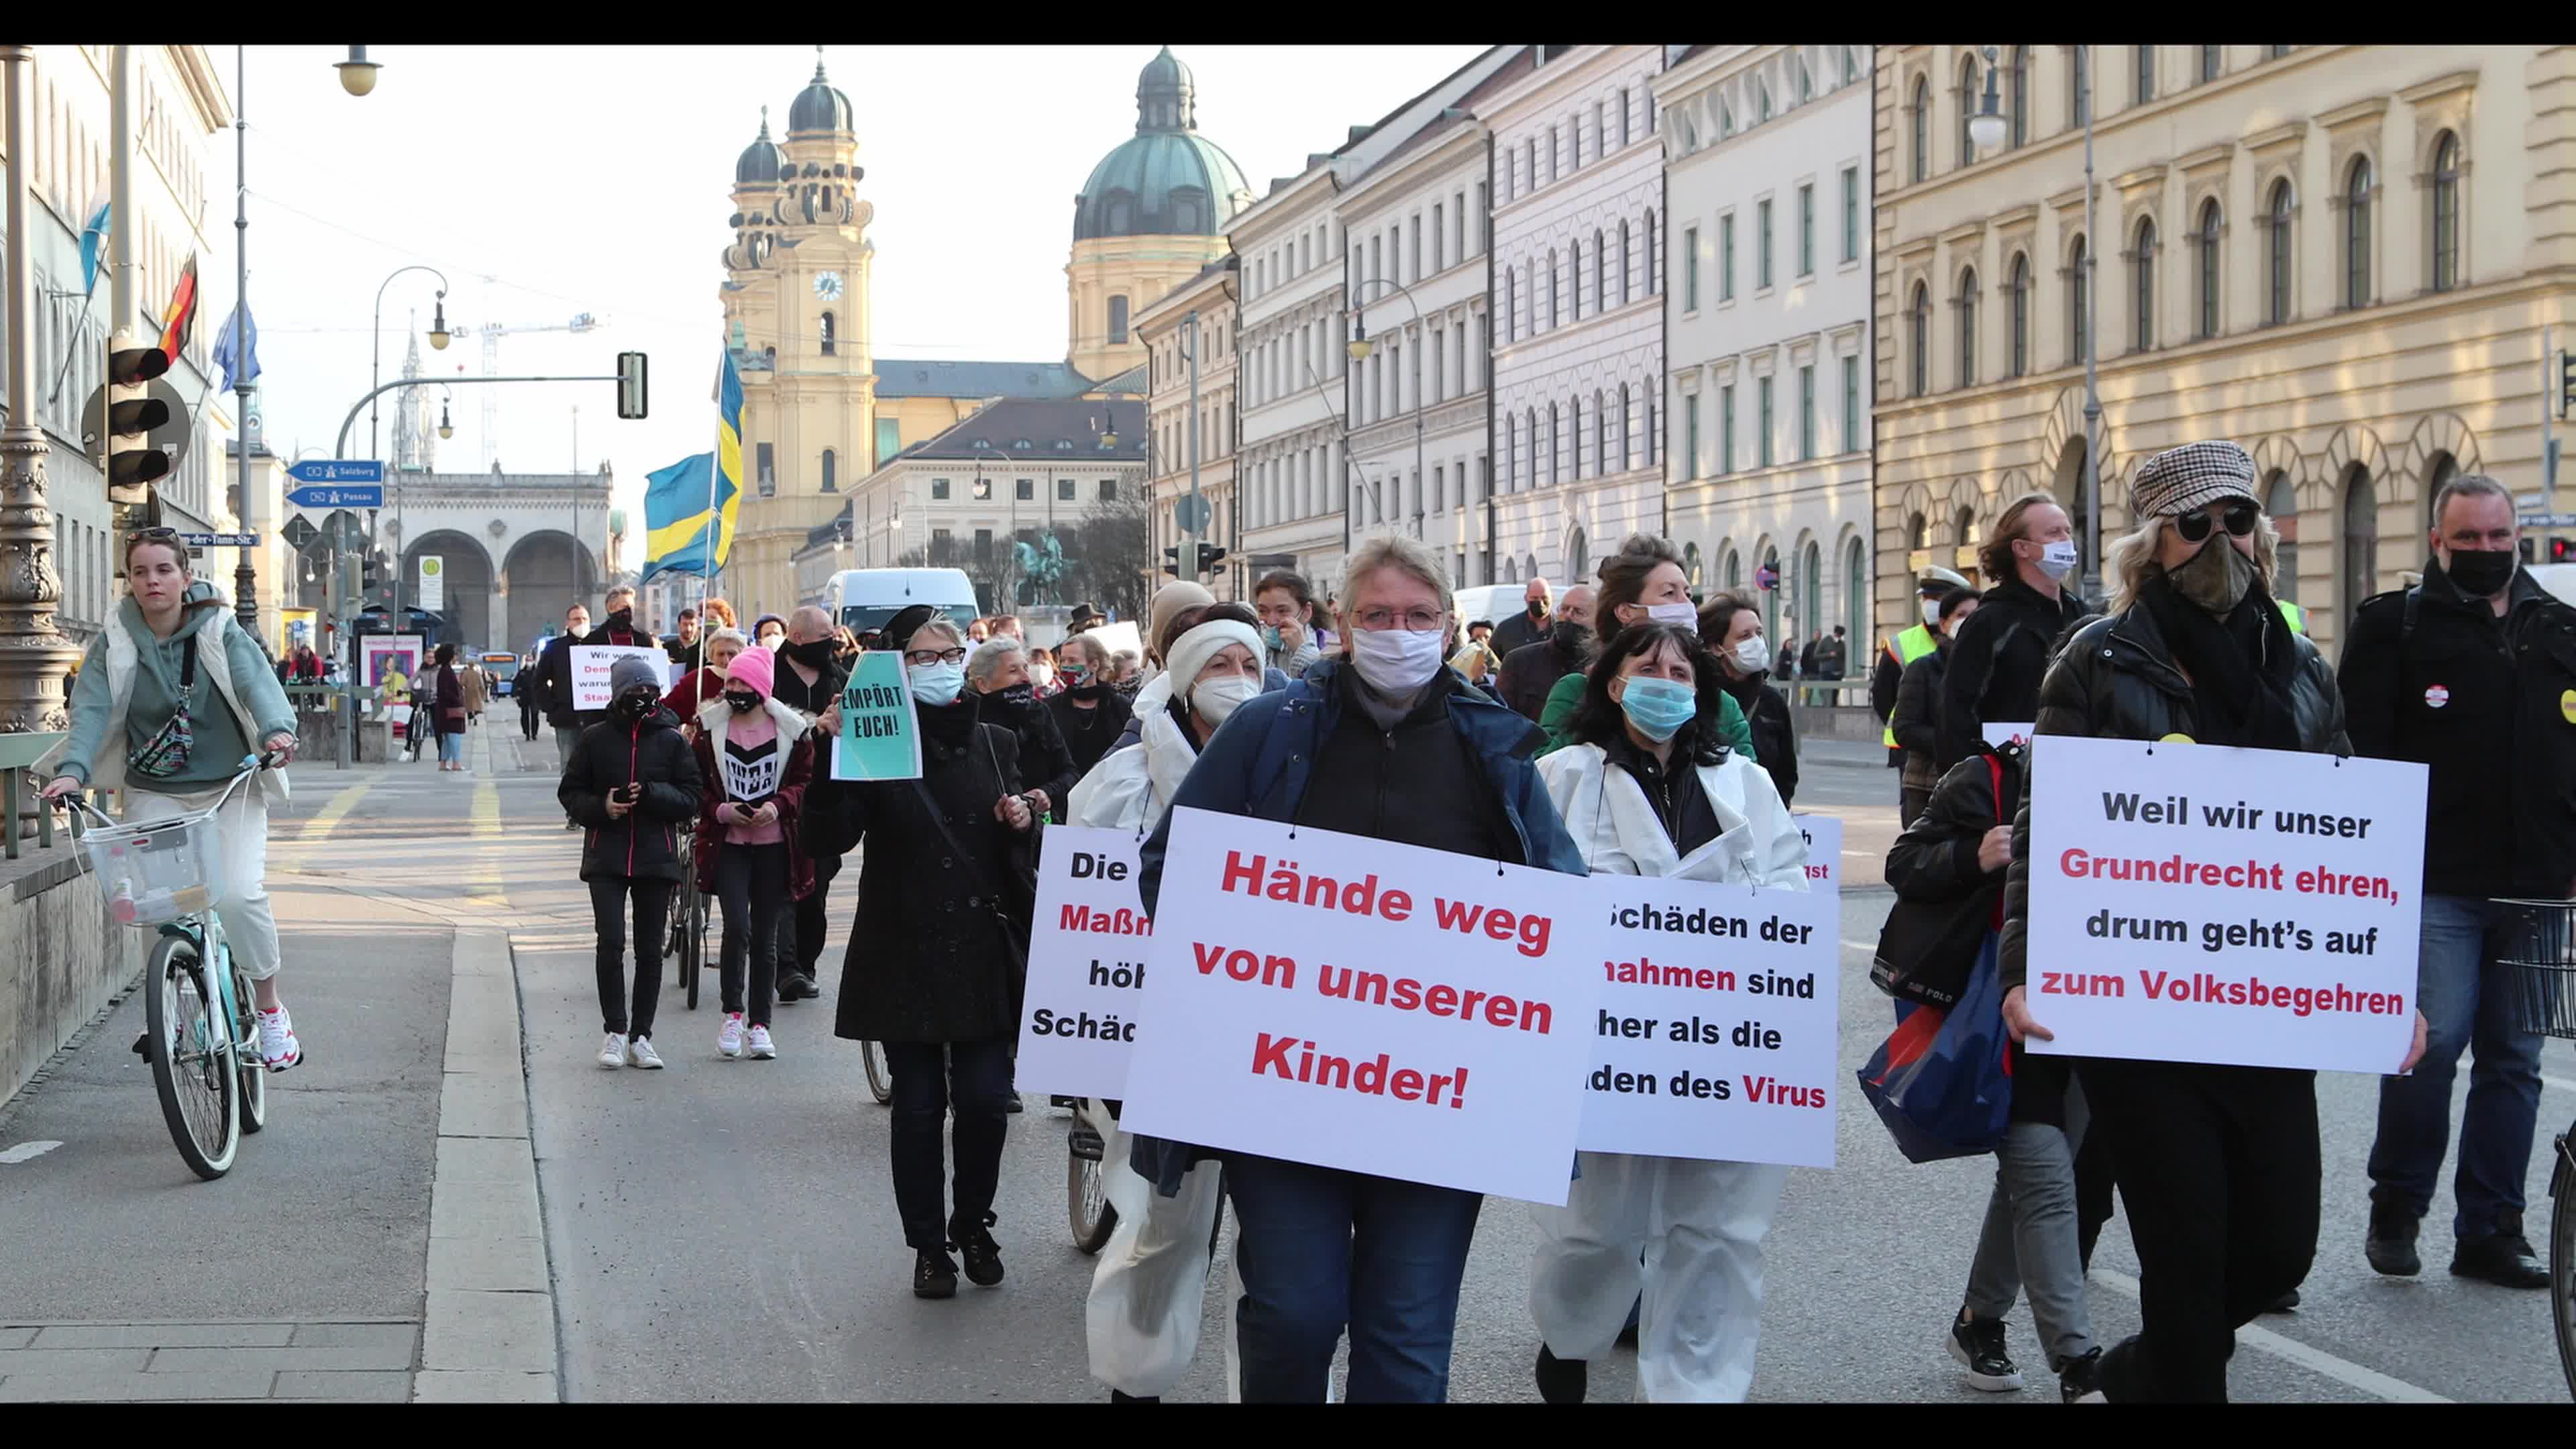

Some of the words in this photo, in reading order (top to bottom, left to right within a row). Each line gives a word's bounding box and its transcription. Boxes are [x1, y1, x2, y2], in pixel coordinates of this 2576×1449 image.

[340, 467, 375, 477] Salzburg
[590, 651, 608, 659] Wir
[584, 694, 612, 702] Staa
[842, 684, 903, 710] EMPÖRT
[854, 715, 900, 738] EUCH!
[2102, 792, 2188, 825] Weil
[2202, 800, 2263, 830] wir
[2275, 811, 2372, 839] unser
[1071, 852, 1128, 881] Die
[2060, 848, 2284, 891] Grundrecht
[2295, 865, 2398, 906] ehren,
[1221, 850, 1412, 922] Hände
[1434, 897, 1552, 958] weg
[1610, 903, 1748, 938] chäden
[1760, 914, 1813, 945] der
[2086, 908, 2188, 943] drum
[2325, 926, 2378, 956] auf
[1192, 942, 1296, 989] von
[1318, 964, 1552, 1034] unseren
[1747, 968, 1815, 1000] sind
[2041, 972, 2125, 998] zum
[2139, 969, 2404, 1017] Volksbegehren
[1594, 1008, 1659, 1039] her
[1668, 1016, 1720, 1044] als
[1731, 1020, 1782, 1050] die
[1252, 1032, 1468, 1110] Kinder!
[1585, 1064, 1657, 1095] den
[1669, 1070, 1731, 1101] des
[1742, 1074, 1826, 1109] Virus
